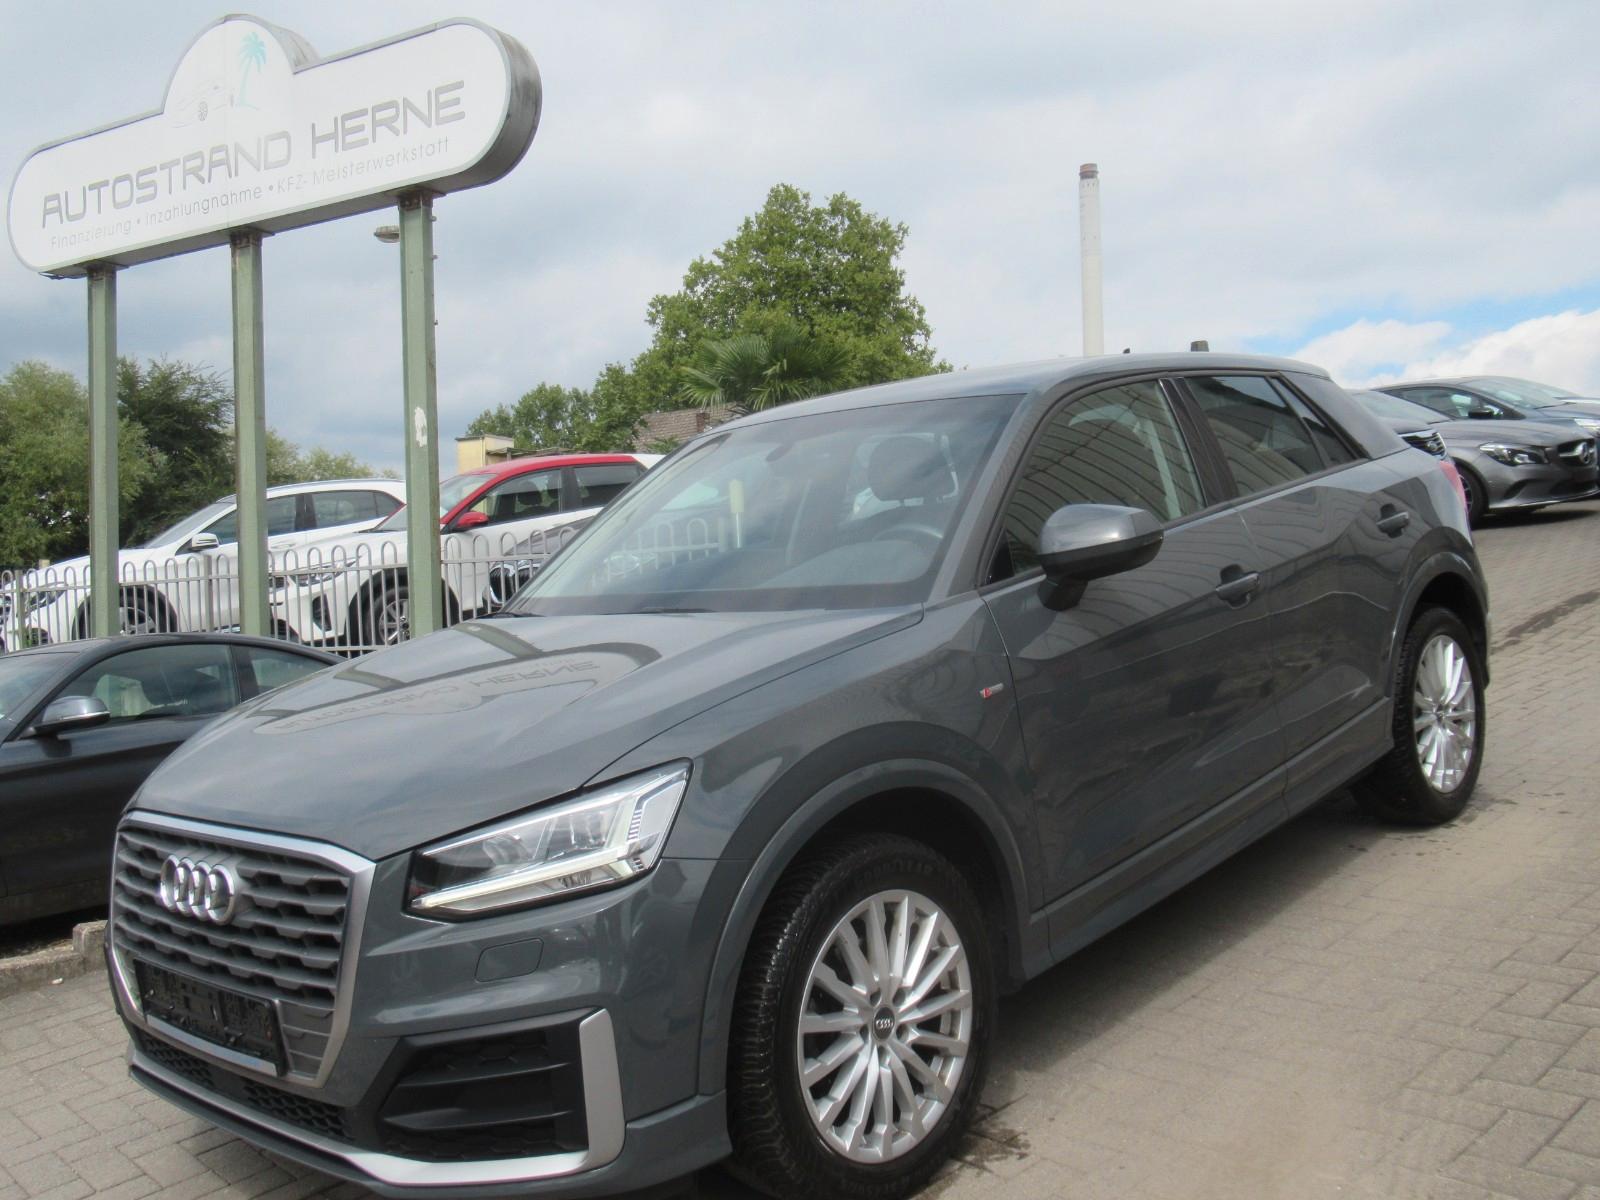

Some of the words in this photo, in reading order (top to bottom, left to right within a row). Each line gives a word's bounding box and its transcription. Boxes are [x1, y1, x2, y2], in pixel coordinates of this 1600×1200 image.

[42, 130, 292, 229] AUTOSTRAND
[311, 80, 466, 159] HERNE
[51, 218, 132, 249] Finanzierung
[312, 135, 449, 186] Meisterwerkstatt
